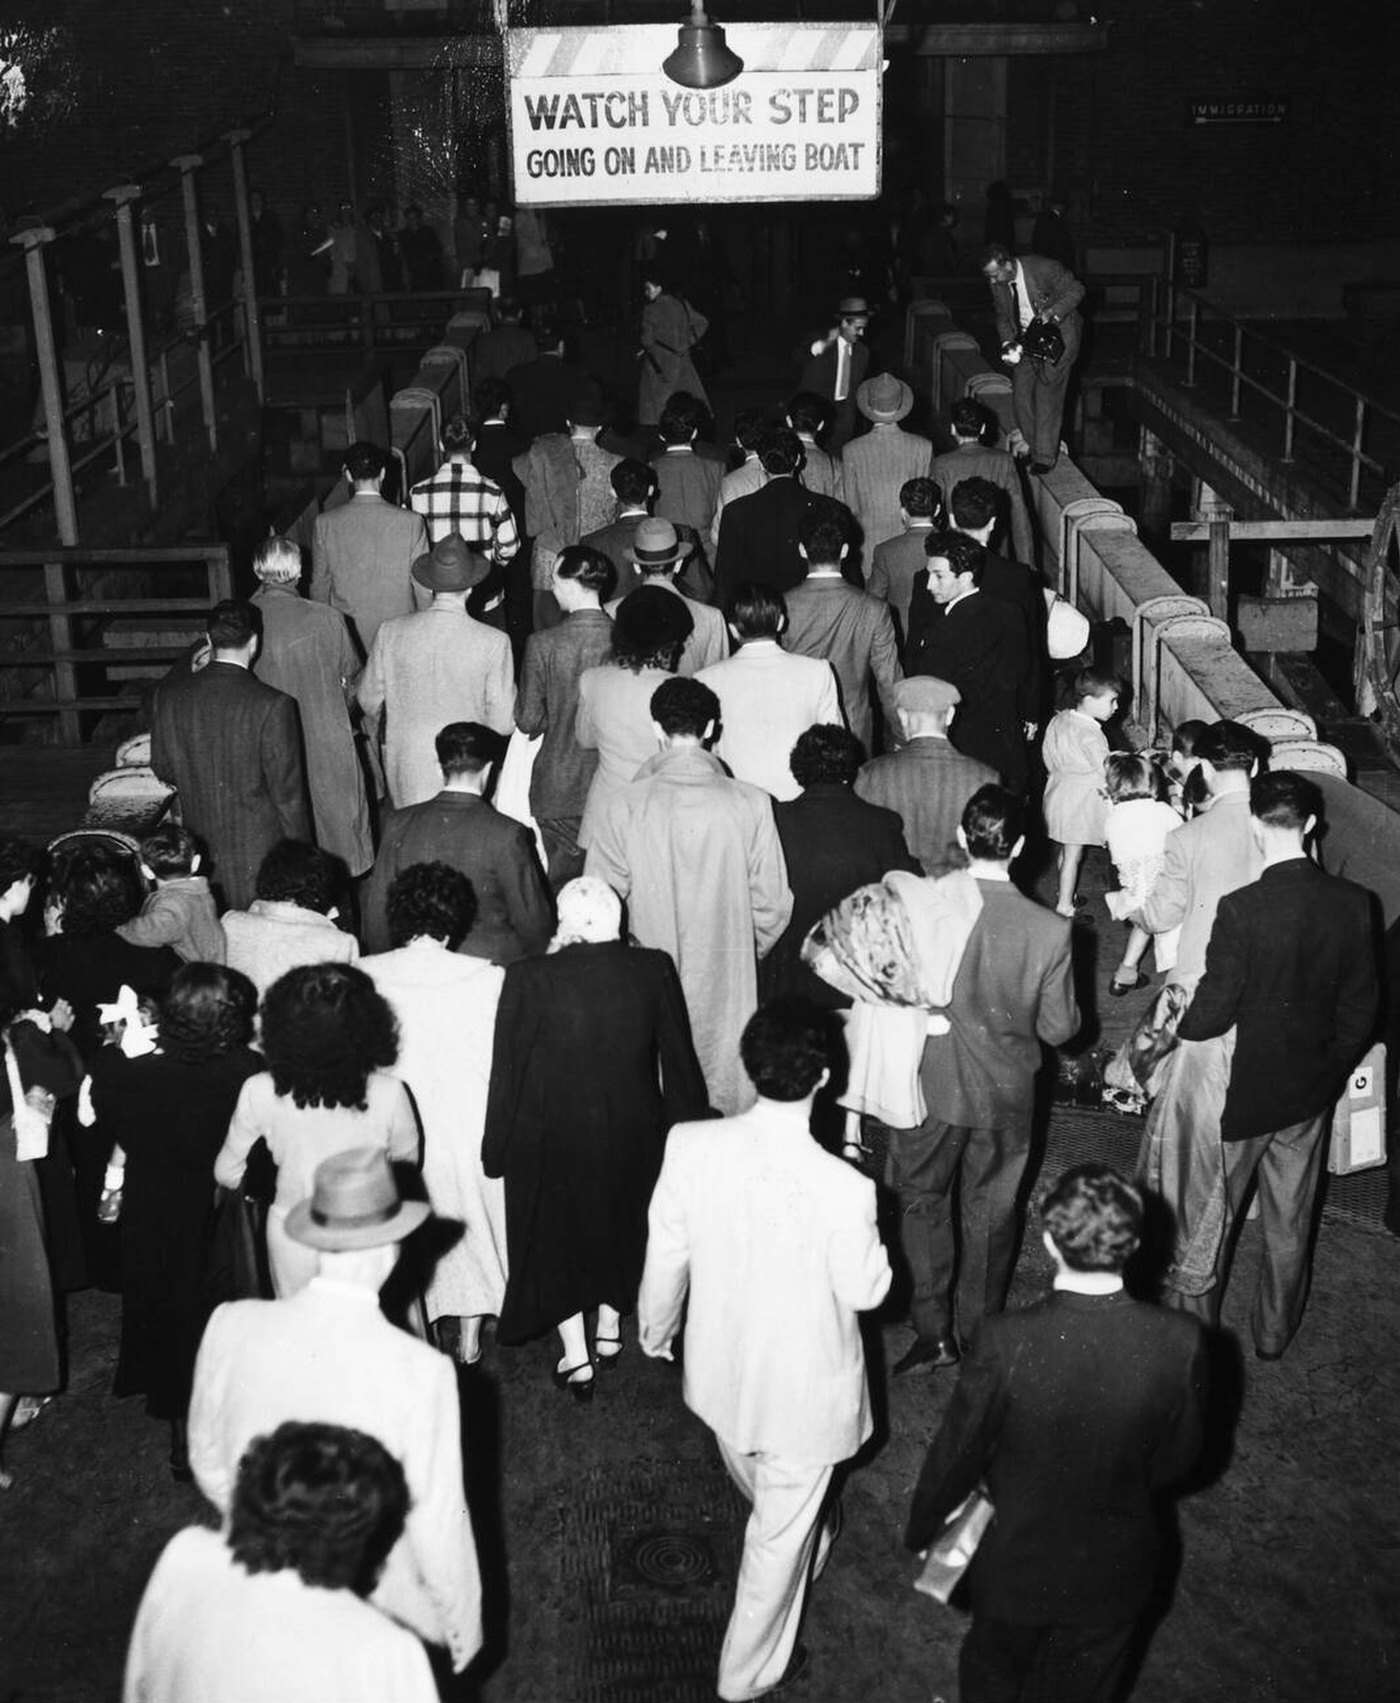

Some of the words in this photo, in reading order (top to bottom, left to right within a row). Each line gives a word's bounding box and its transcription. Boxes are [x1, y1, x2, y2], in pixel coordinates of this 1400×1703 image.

[524, 91, 649, 130] WATCH
[660, 89, 752, 127] YOUR
[769, 88, 860, 125] STEP
[1192, 104, 1286, 115] IMMIGRATION
[526, 147, 595, 178] GOING
[604, 146, 636, 176] ON
[644, 145, 691, 175] AND
[700, 143, 796, 173] LEAVING
[804, 142, 865, 172] BOAT
